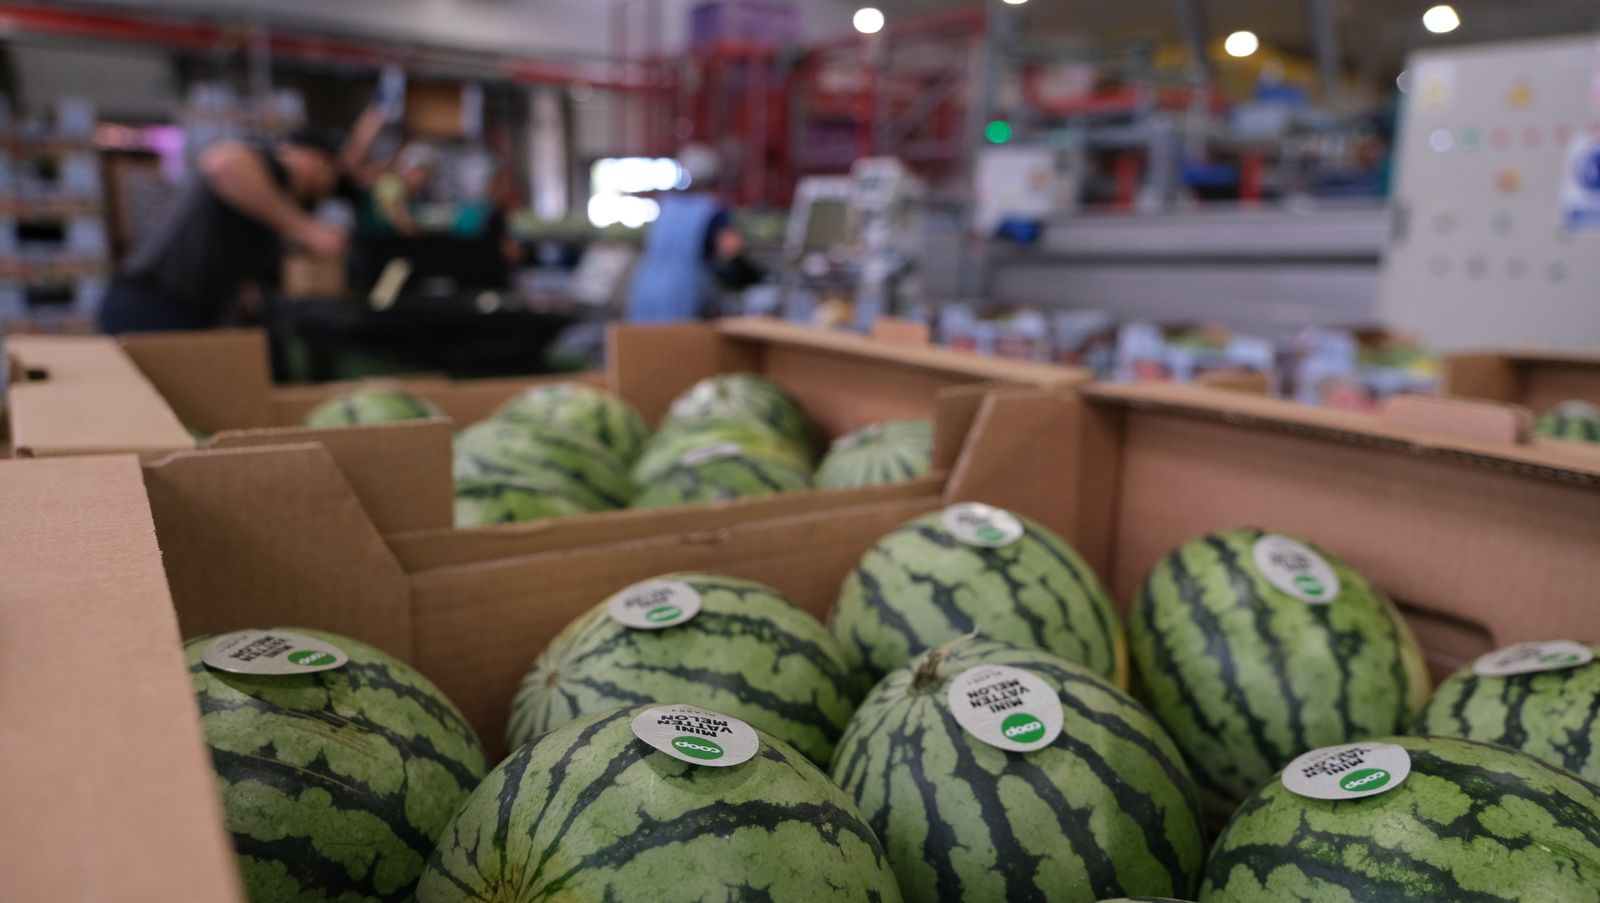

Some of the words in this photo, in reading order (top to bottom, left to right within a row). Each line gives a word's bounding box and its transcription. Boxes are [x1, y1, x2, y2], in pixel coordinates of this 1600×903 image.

[966, 678, 1020, 699] MELON
[969, 685, 1030, 709] VATTEN
[989, 697, 1023, 713] MINI
[657, 720, 733, 734] VATTEN
[660, 715, 728, 727] MELON
[1005, 722, 1041, 737] coop
[675, 726, 717, 738] MINI
[675, 741, 721, 753] coop
[1301, 747, 1359, 773] MELON
[1303, 749, 1371, 779] VATTEN
[1325, 757, 1364, 776] MINI
[1344, 771, 1386, 789] coop
